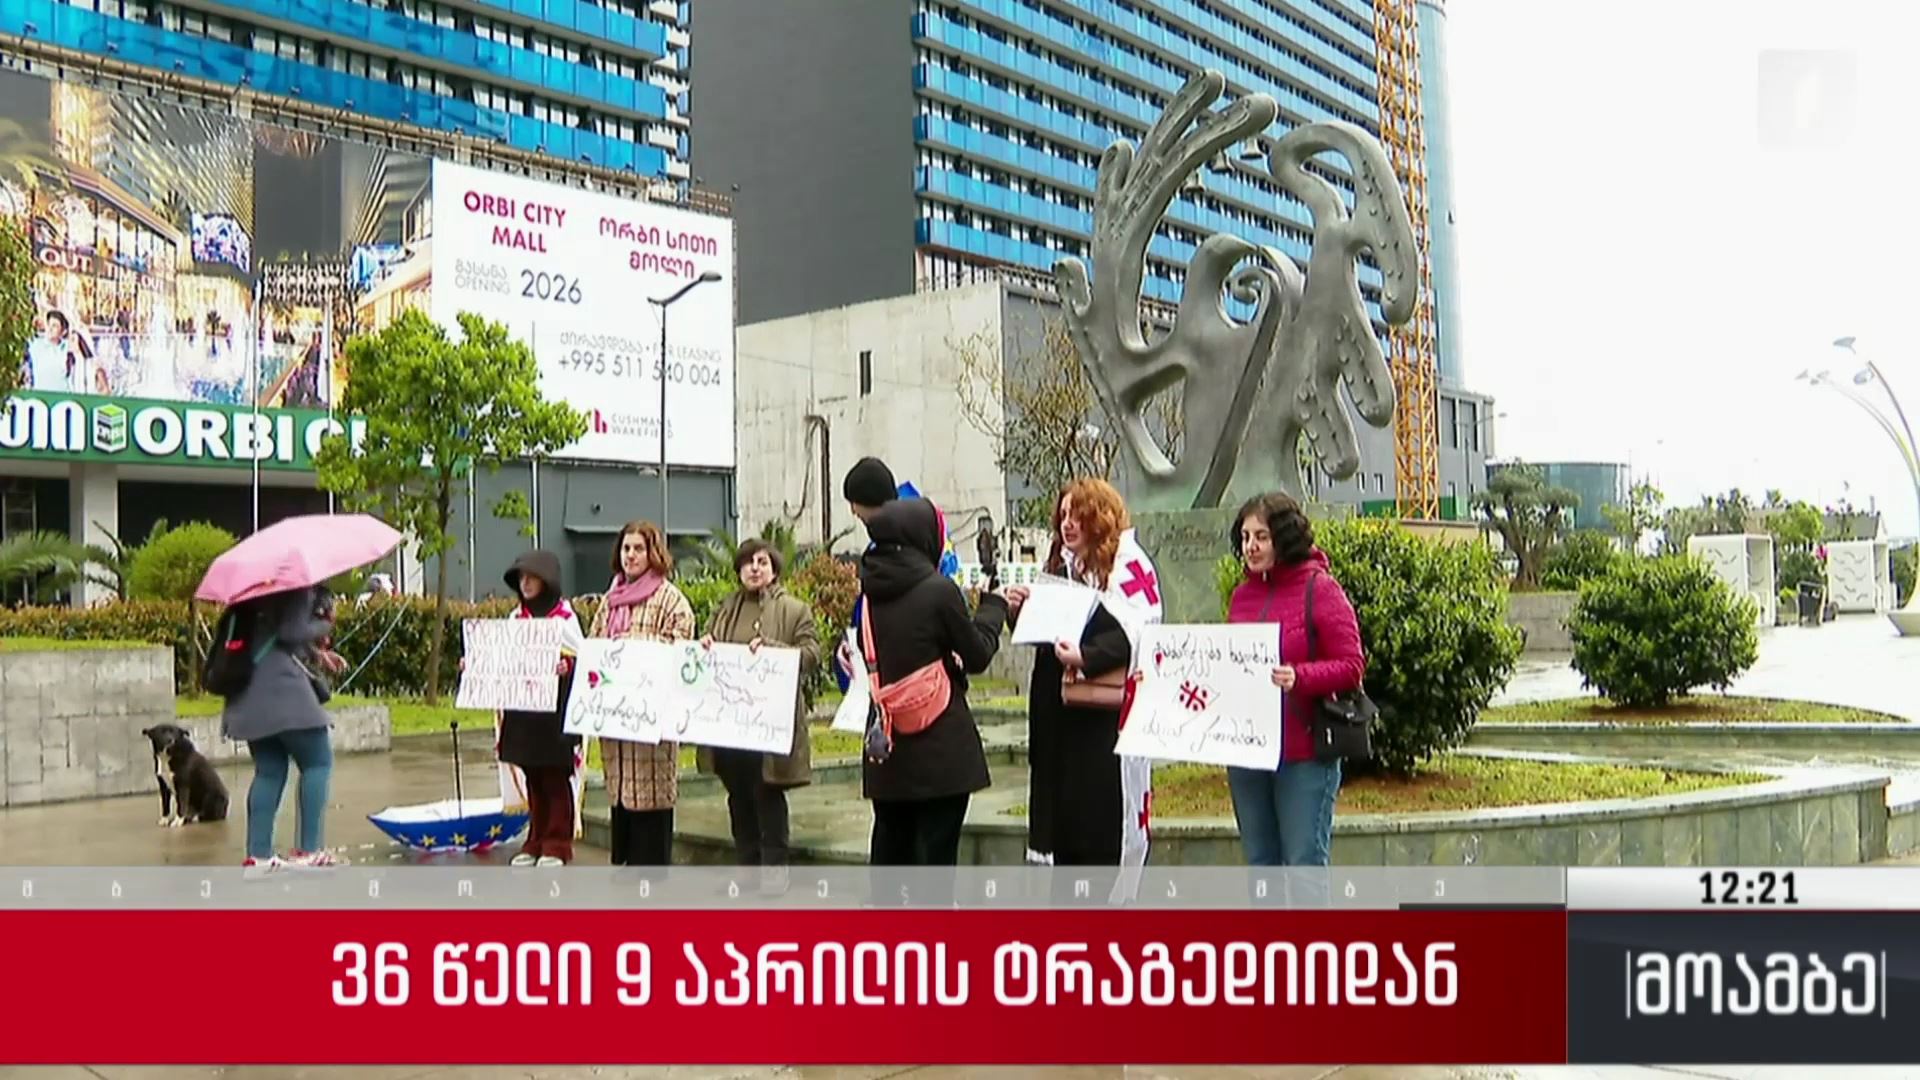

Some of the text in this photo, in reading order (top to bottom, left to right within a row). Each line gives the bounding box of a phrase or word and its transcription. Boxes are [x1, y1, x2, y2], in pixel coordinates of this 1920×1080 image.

[464, 190, 566, 227] ORBI CITY
[491, 225, 547, 253] MALL
[599, 217, 717, 256] ორბი სითი
[629, 250, 695, 278] მოლი
[455, 275, 511, 296] OPENING
[520, 268, 583, 305] 2026
[559, 349, 606, 375] +995
[612, 355, 643, 378] 511
[689, 364, 722, 387] 004
[652, 343, 674, 358] FR
[677, 346, 723, 362] LEASING
[133, 406, 293, 462] ORBI
[611, 425, 674, 439] WAKEFIED
